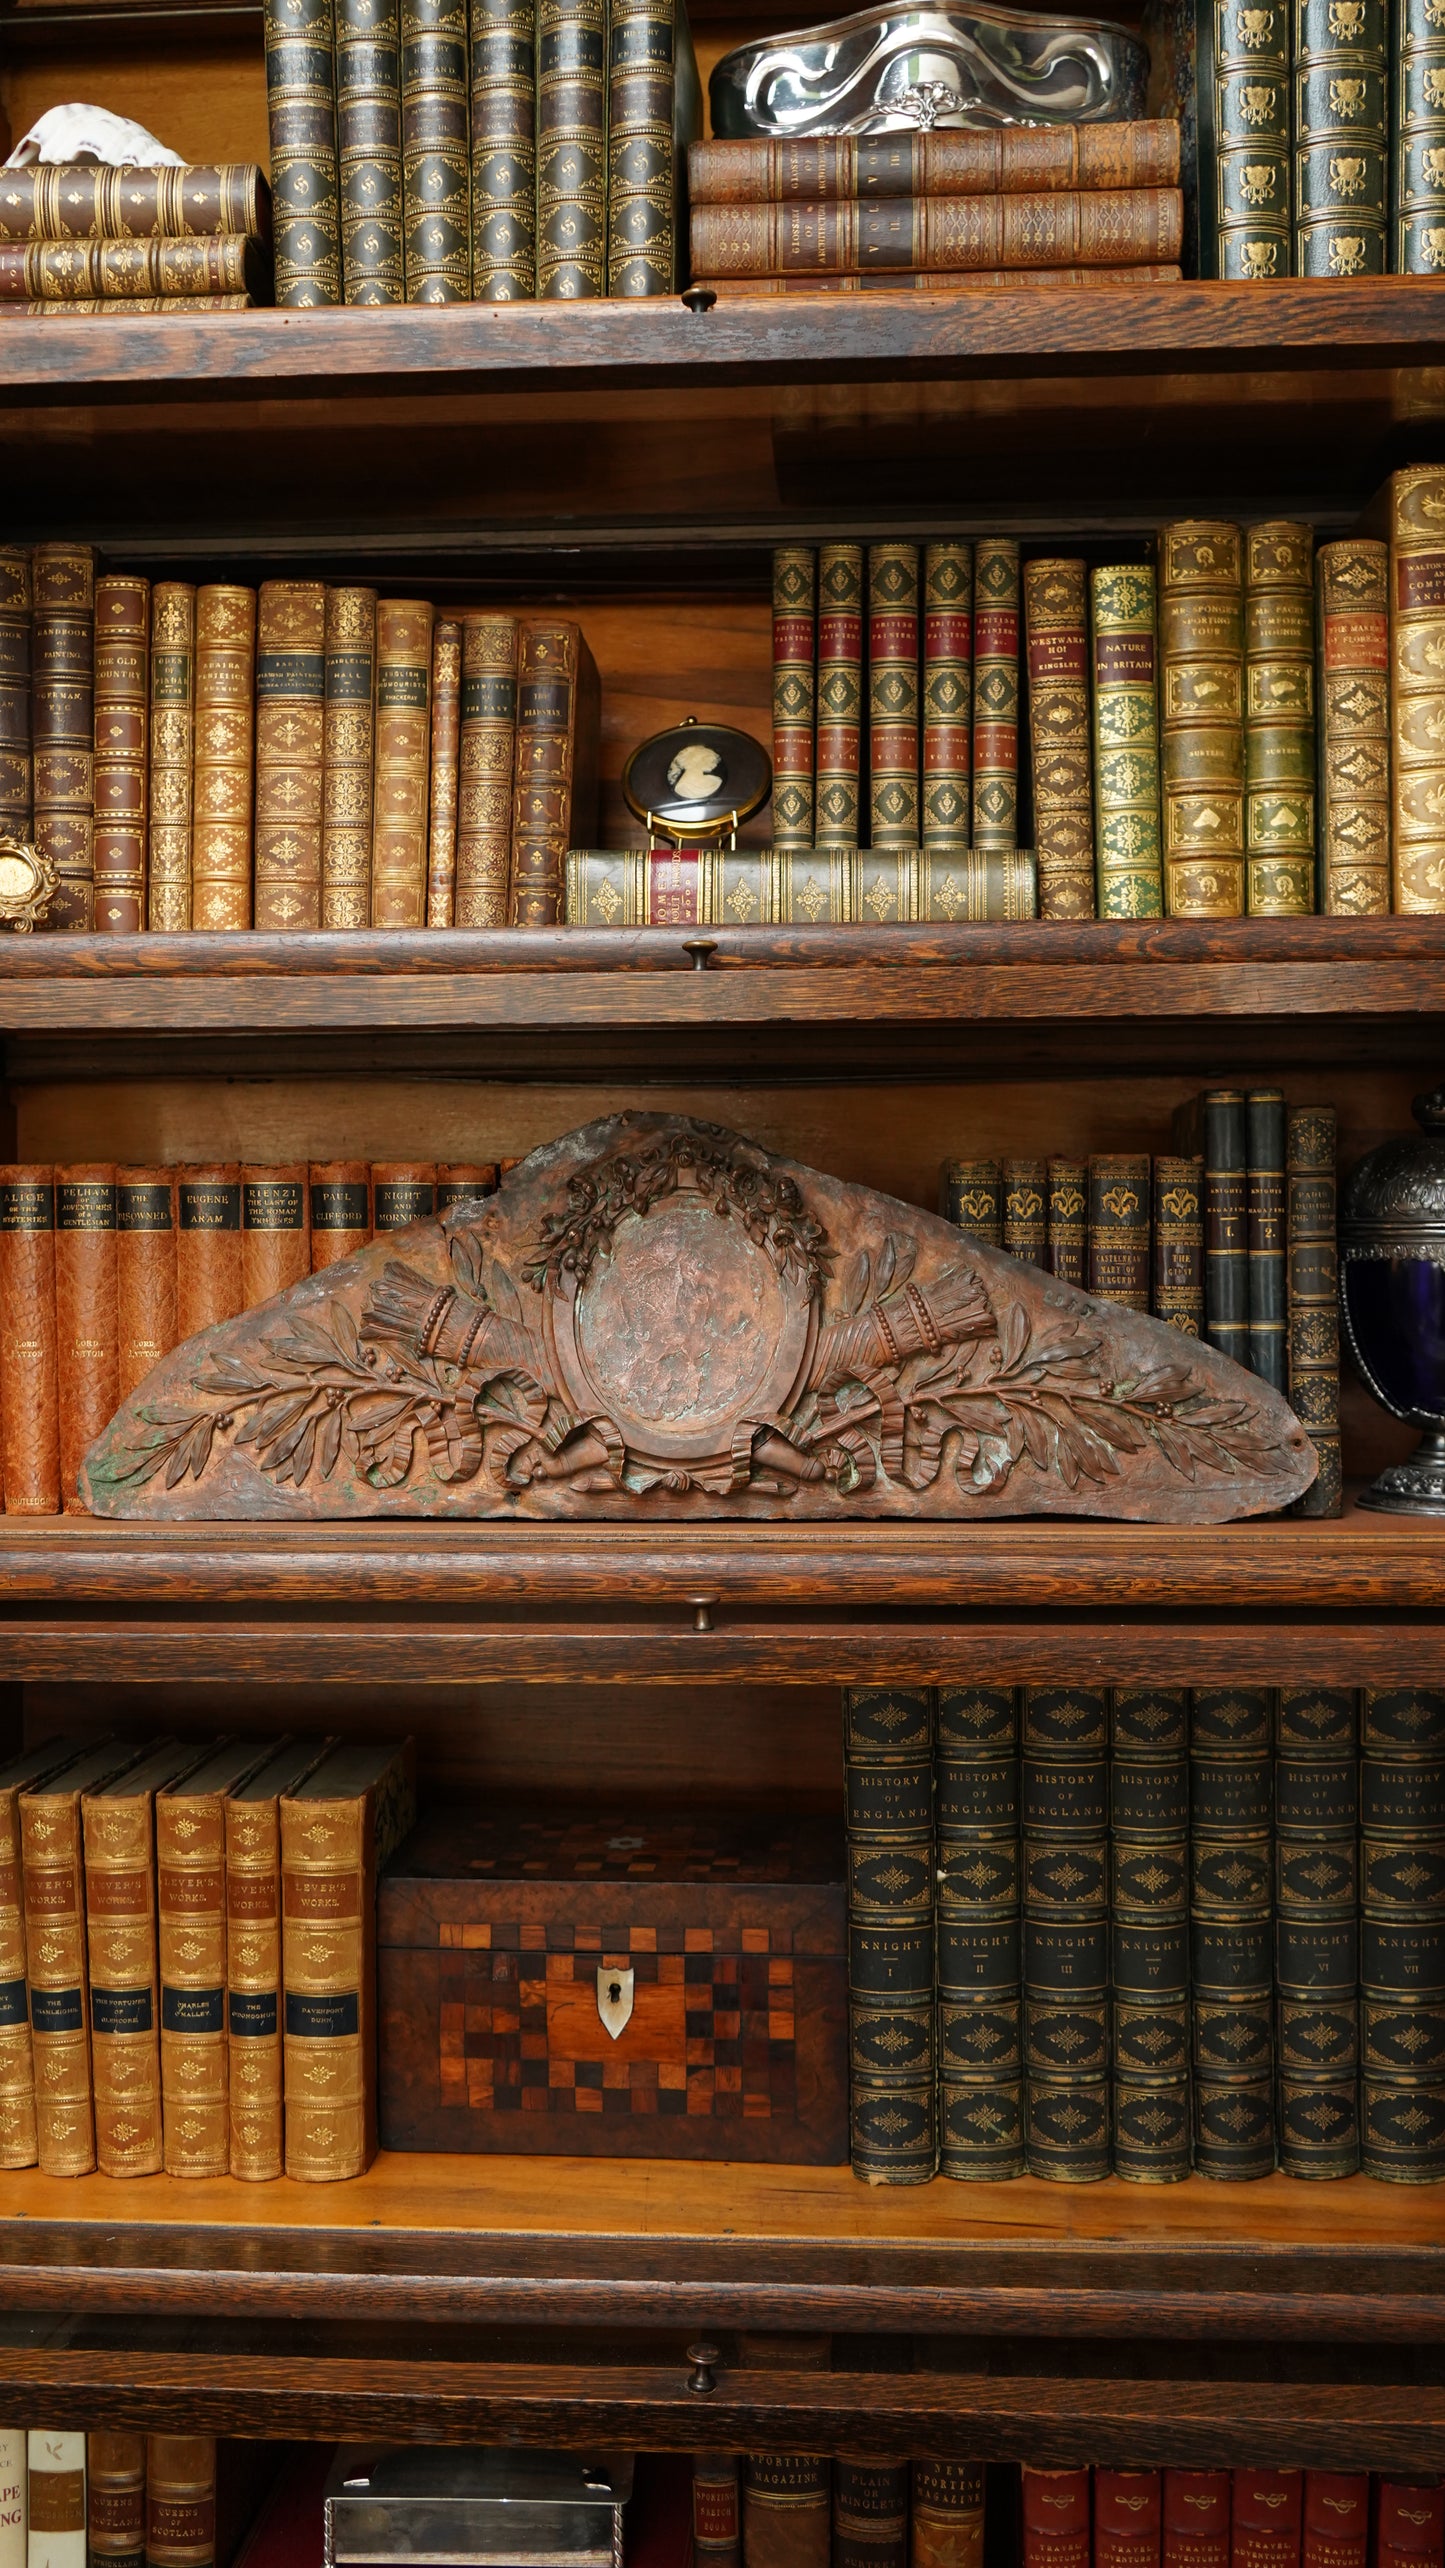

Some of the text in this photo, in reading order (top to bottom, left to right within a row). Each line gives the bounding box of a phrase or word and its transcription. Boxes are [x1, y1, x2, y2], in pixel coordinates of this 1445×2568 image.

[1190, 628, 1221, 637] TOUR
[1048, 645, 1068, 655] HO!
[1105, 643, 1147, 653] NATURE
[98, 656, 138, 666] THE OLD
[1097, 661, 1152, 671] IN BRITAIN
[95, 670, 142, 681] COUNTRY
[165, 667, 176, 675] OF
[334, 672, 363, 680] HALL
[671, 850, 681, 888] HANDS
[4, 1192, 45, 1203] ALICE
[63, 1188, 109, 1197] PELHAM
[249, 1189, 297, 1198] RIENZI
[323, 1193, 351, 1201] PAUL
[384, 1191, 421, 1200] NIGHT
[131, 1195, 148, 1203] THE
[186, 1195, 229, 1204] EUGENE
[62, 1204, 113, 1212] ADVENTURES
[191, 1215, 223, 1223] ARAM
[316, 1212, 363, 1221] CLIFFORD
[1264, 1227, 1276, 1238] 2.
[1059, 1254, 1078, 1263] THE
[1172, 1254, 1192, 1263] THE
[1100, 1265, 1136, 1274] MARY OF
[15, 1340, 38, 1348] LORD
[75, 1339, 99, 1347] LORD
[860, 1776, 920, 1787] HISTORY
[949, 1771, 1008, 1782] HISTORY
[1035, 1774, 1095, 1785] HISTORY
[1120, 1775, 1180, 1786] HISTORY
[1201, 1772, 1261, 1783] HISTORY
[1288, 1772, 1348, 1783] HISTORY
[1380, 1773, 1441, 1784] HISTORY
[884, 1795, 900, 1803] OF
[972, 1791, 988, 1799] OF
[1058, 1792, 1074, 1800] OF
[1146, 1793, 1163, 1801] OF
[1224, 1791, 1241, 1799] OF
[1312, 1791, 1329, 1799] OF
[1405, 1791, 1422, 1799] OF
[852, 1808, 928, 1820] ENGLAND
[940, 1803, 1015, 1815] ENGLAND
[1029, 1805, 1103, 1817] ENGLAND
[1113, 1806, 1188, 1818] ENGLAND
[1193, 1804, 1268, 1817] ENGLAND
[1280, 1804, 1356, 1816] ENGLAND
[164, 1878, 214, 1887] LEVER'S
[296, 1883, 346, 1892] LEVER'S
[30, 1896, 66, 1905] WORKS.
[97, 1896, 136, 1905] WORKS.
[169, 1894, 207, 1902] WORKS.
[301, 1898, 340, 1907] WORKS.
[233, 1901, 270, 1910] WORKS.
[950, 1936, 1010, 1947] KNIGHT
[1035, 1936, 1096, 1948] KNIGHT
[1121, 1939, 1181, 1951] KNIGHT
[1203, 1935, 1264, 1947] KNIGHT
[1288, 1934, 1350, 1946] KNIGHT
[1378, 1936, 1440, 1948] KNIGHT
[861, 1940, 922, 1951] KNIGHT
[887, 1968, 893, 1977] I
[976, 1965, 984, 1974] II
[1061, 1965, 1073, 1974] III
[1148, 1966, 1160, 1976] IV
[1232, 1964, 1241, 1974] V
[1318, 1963, 1330, 1972] VI
[1404, 1964, 1420, 1974] VII
[302, 2007, 345, 2015] DAVENPORT
[935, 2463, 965, 2476] NEW
[755, 2471, 818, 2484] MAGAZINE
[851, 2474, 891, 2487] PLAIN
[916, 2473, 981, 2490] SPORTING
[696, 2491, 735, 2502] SPORTING
[864, 2489, 879, 2497] OR
[917, 2487, 981, 2505] MAGAZINE
[158, 2508, 198, 2518] QUEENS
[152, 2526, 204, 2537] SCOTLAND
[1028, 2553, 1082, 2562] ADVENTURE
[1100, 2552, 1150, 2563] ADVENTURE
[1165, 2552, 1220, 2563] ADVENTURE
[1234, 2548, 1287, 2560] ADVENTURE
[1305, 2552, 1359, 2564] ADVENTURE
